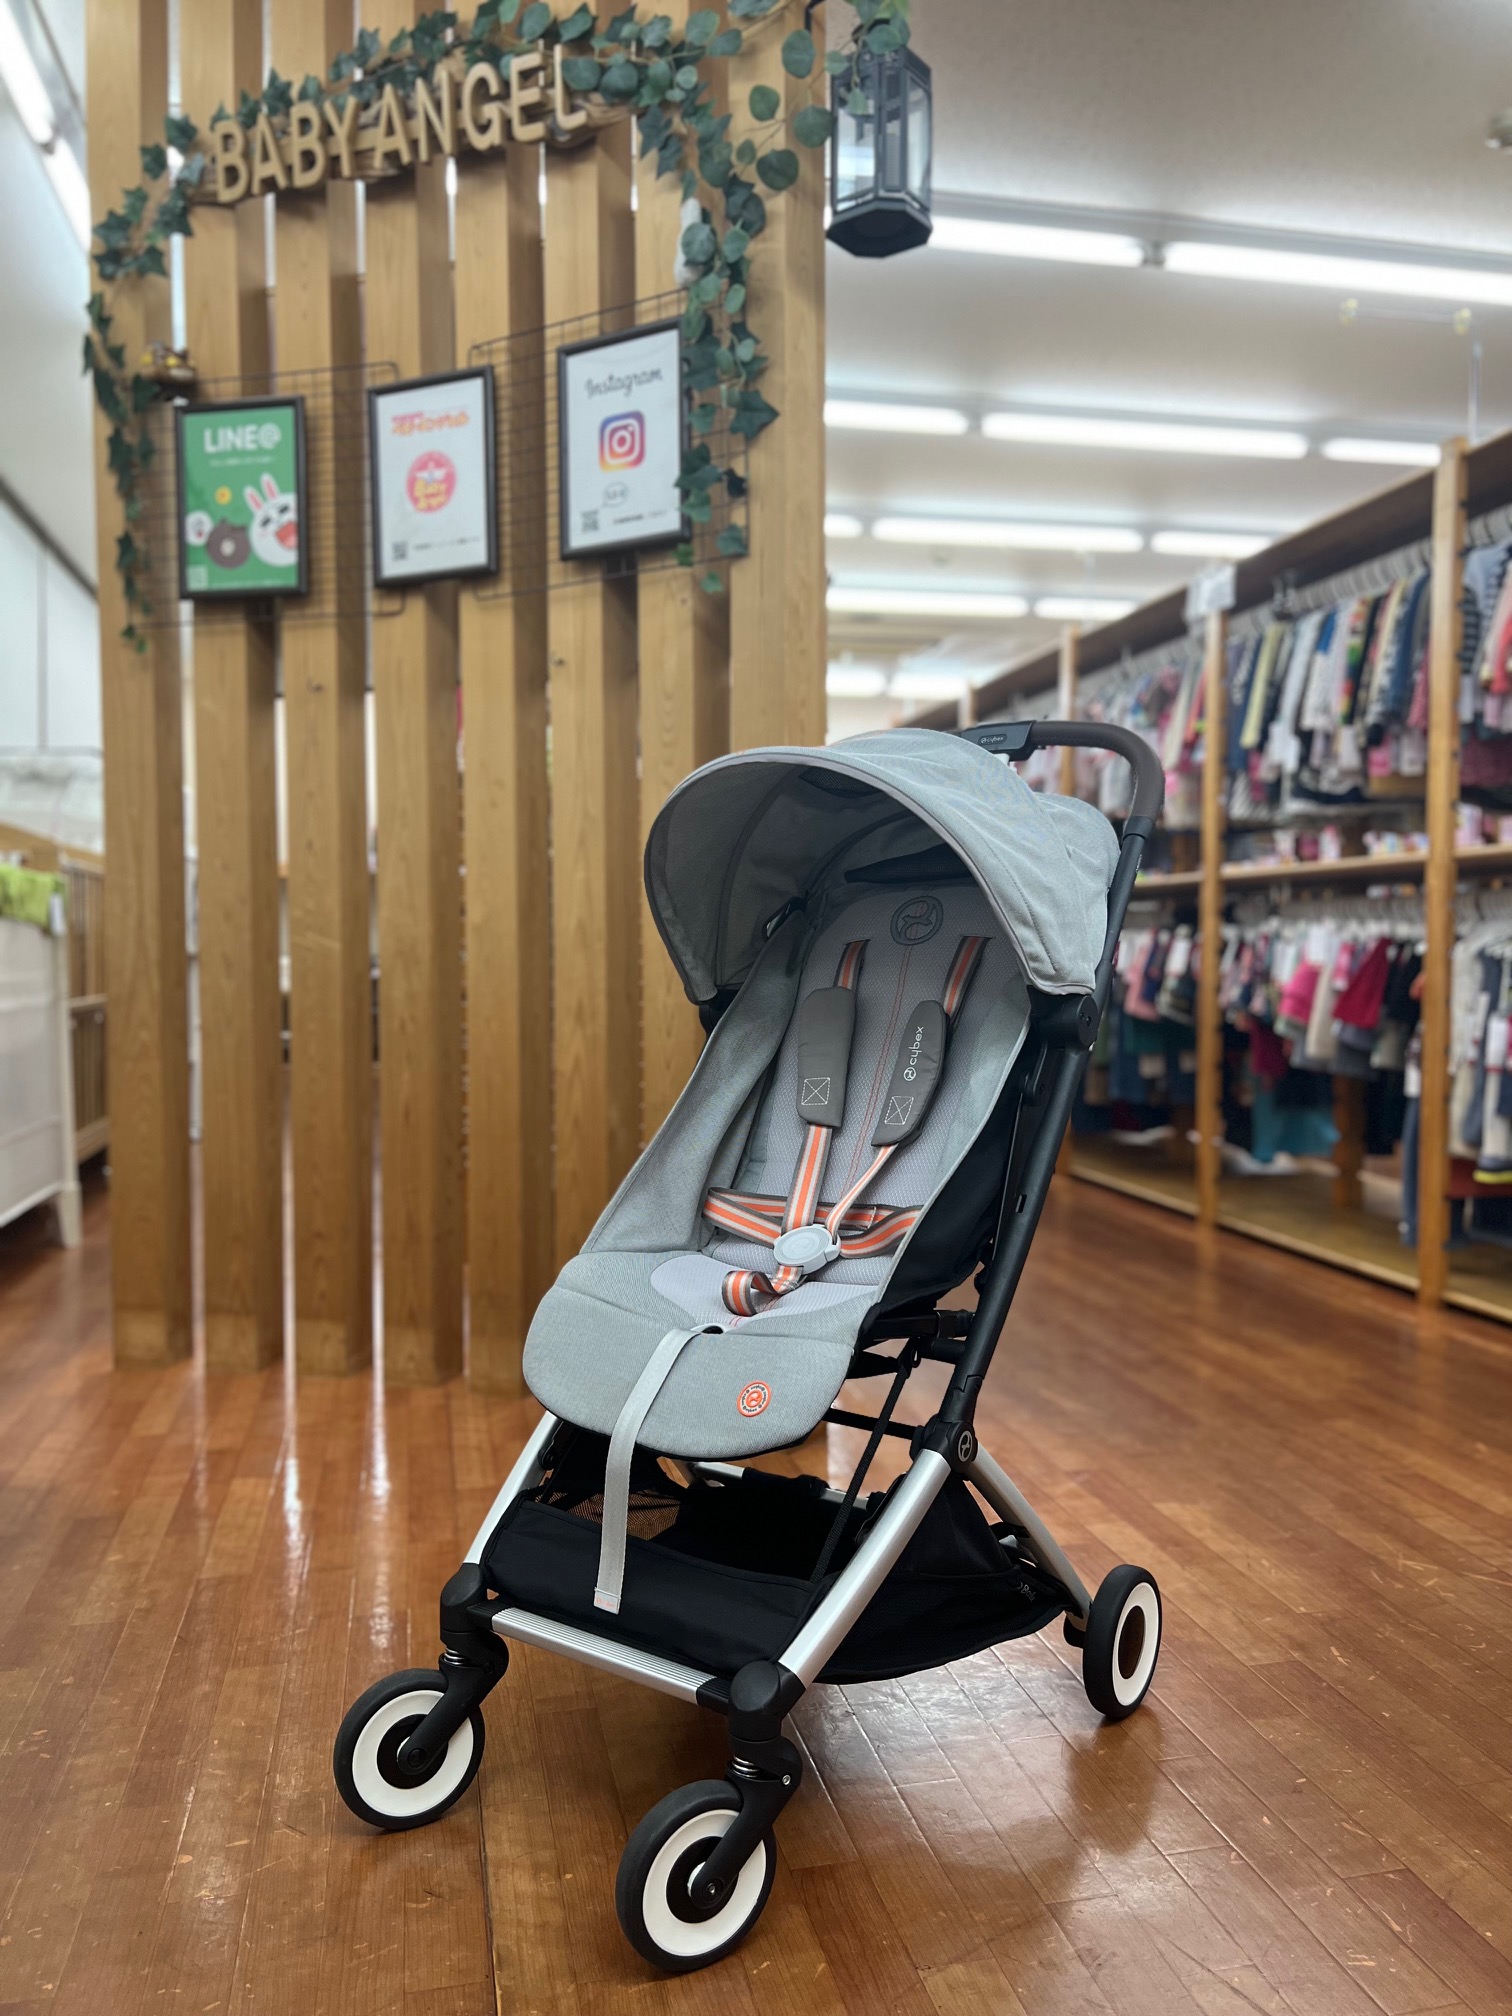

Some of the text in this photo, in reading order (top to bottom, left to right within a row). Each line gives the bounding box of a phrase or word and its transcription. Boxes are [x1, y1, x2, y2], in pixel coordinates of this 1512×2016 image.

[214, 44, 588, 203] BABY ANGEL
[585, 368, 663, 399] Instagram
[204, 422, 281, 453] LINE@
[908, 1026, 924, 1066] cybex
